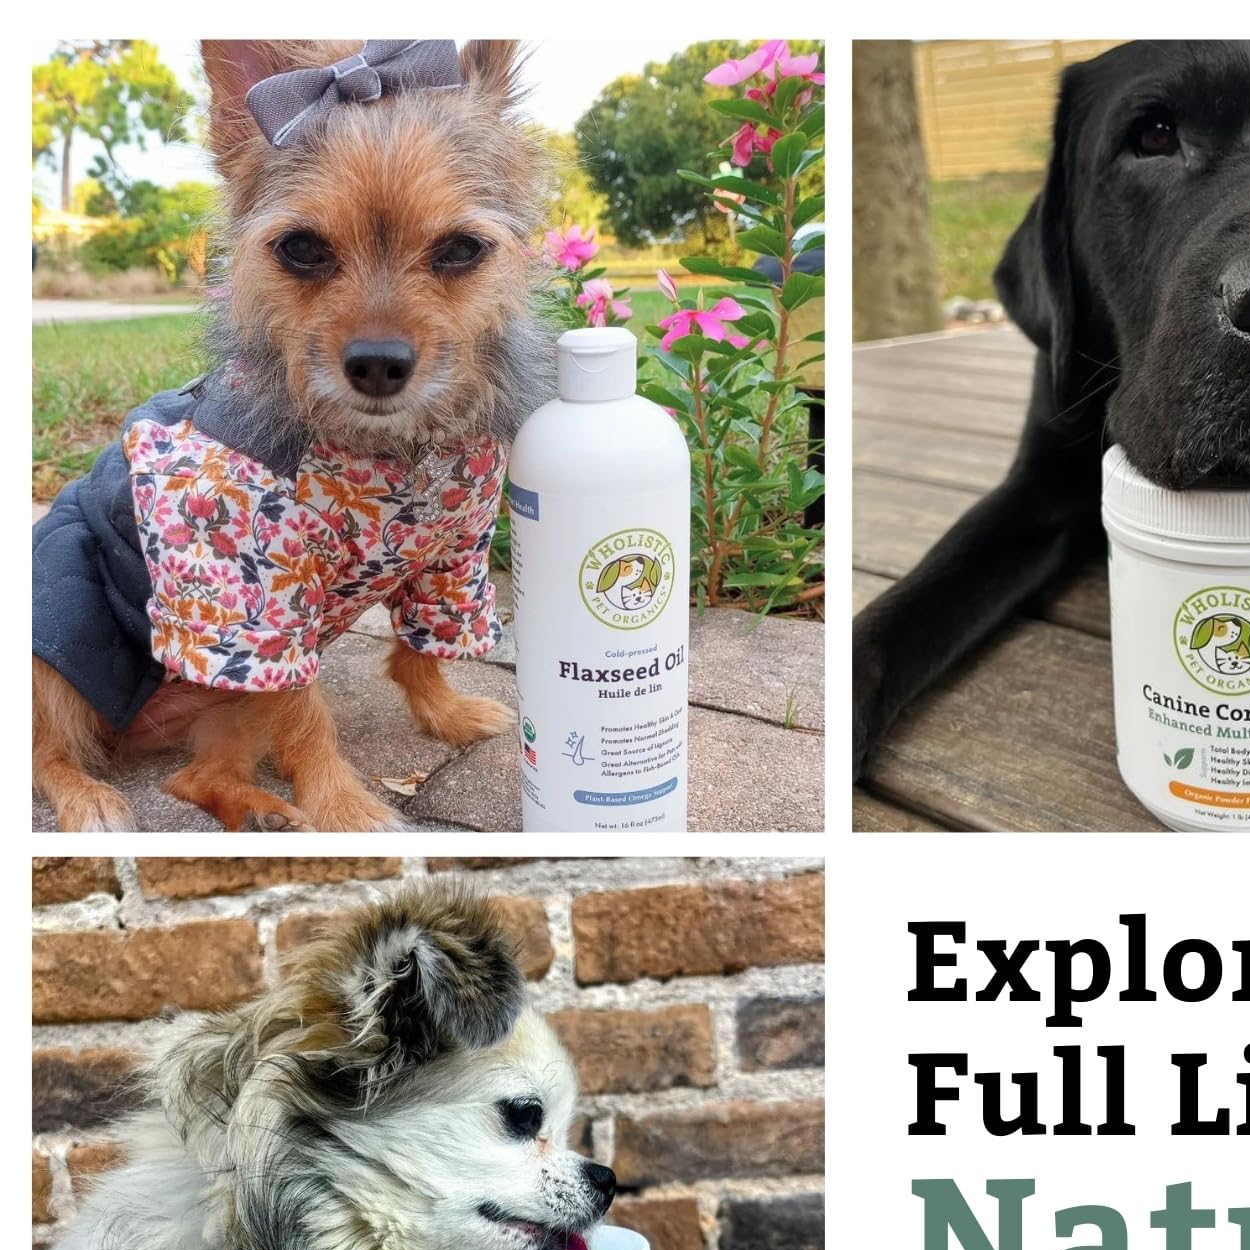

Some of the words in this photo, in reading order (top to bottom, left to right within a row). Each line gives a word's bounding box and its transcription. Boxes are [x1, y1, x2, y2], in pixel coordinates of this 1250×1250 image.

[515, 501, 534, 515] Health
[586, 535, 671, 571] WHOLISTIC
[592, 597, 610, 615] PET
[605, 645, 657, 658] Cold-pressed
[559, 658, 660, 682] Flaxseed
[665, 645, 684, 671] Oil
[1186, 654, 1204, 675] PET
[598, 689, 631, 698] Huile
[634, 688, 646, 696] de
[649, 683, 662, 693] lin
[1143, 685, 1210, 717] Canine
[634, 721, 657, 730] Healthy
[1149, 708, 1212, 736] Enhanced
[634, 731, 657, 741] Normal
[1231, 748, 1250, 756] Body
[623, 757, 657, 766] Alternative
[1211, 757, 1240, 766] Healthy
[1211, 767, 1240, 776] Healthy
[1211, 778, 1240, 787] Healthy
